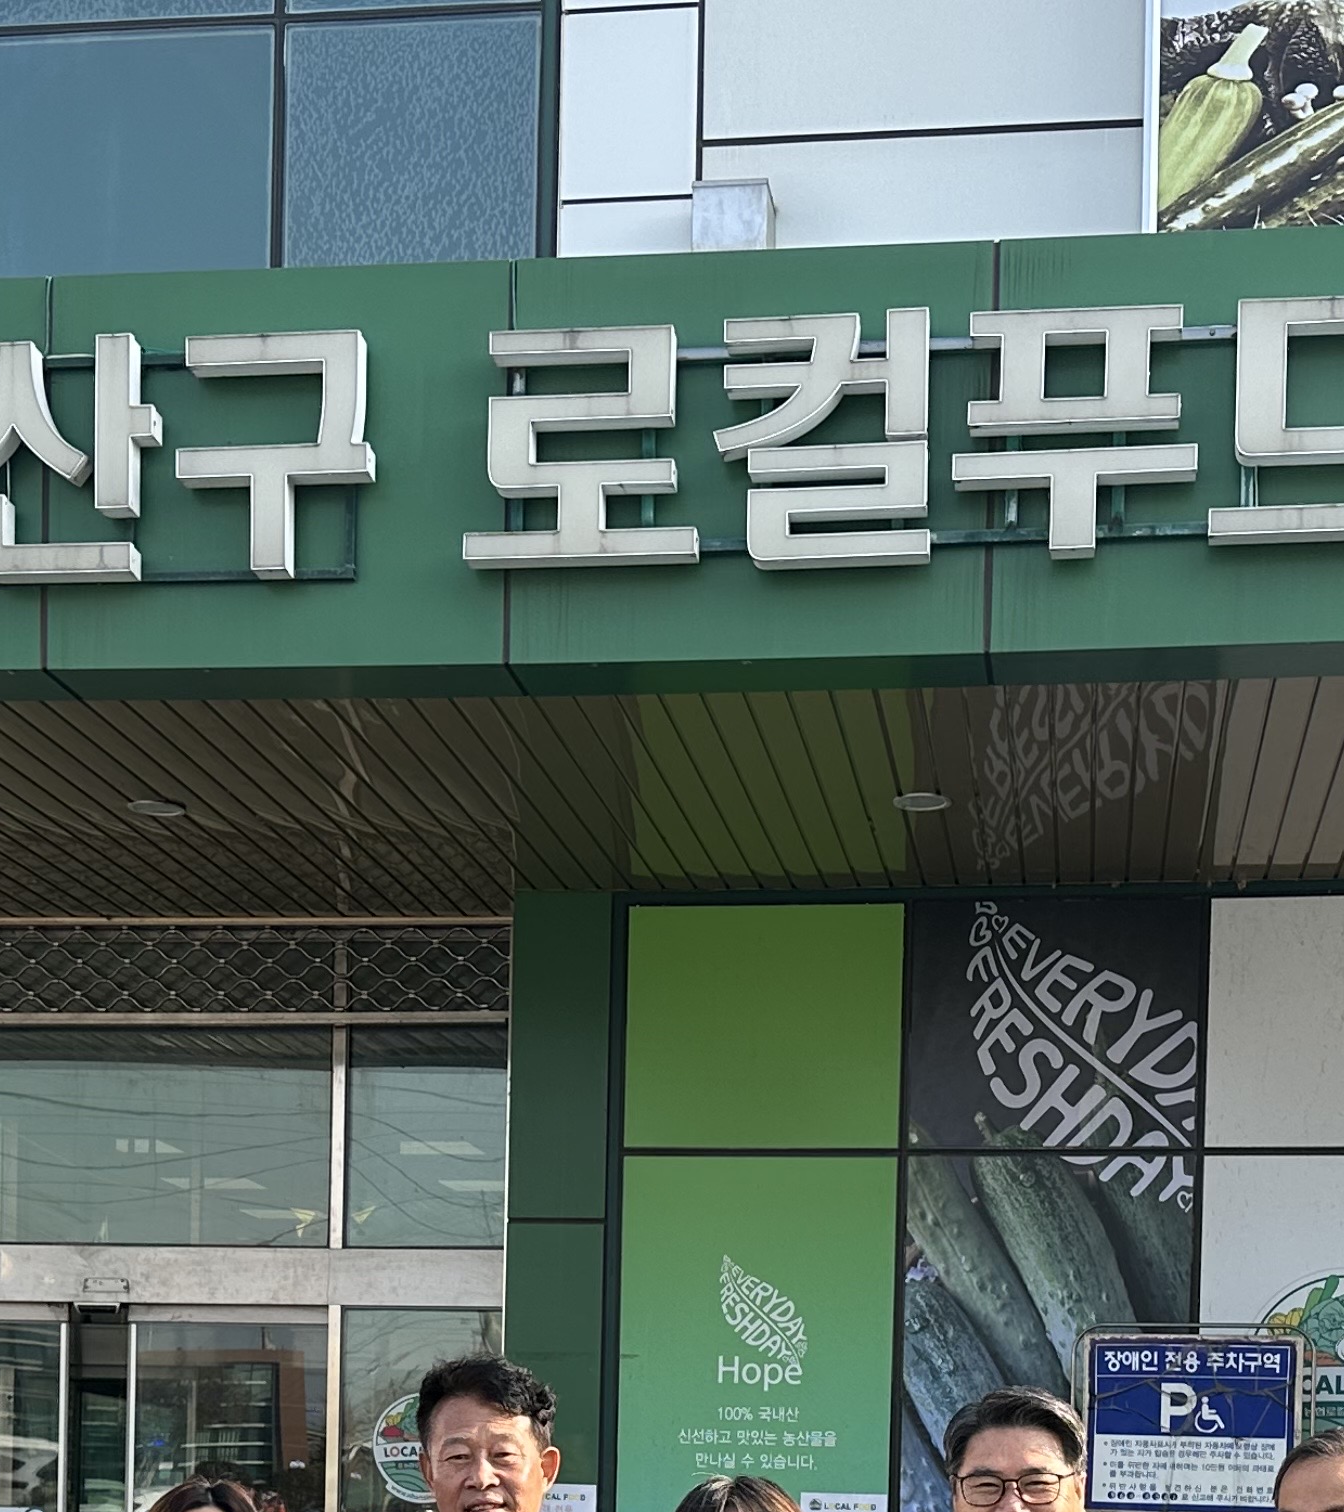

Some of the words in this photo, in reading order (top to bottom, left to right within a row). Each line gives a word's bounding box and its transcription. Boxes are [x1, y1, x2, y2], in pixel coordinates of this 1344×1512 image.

[1104, 1350, 1158, 1372] 장애인
[1164, 1351, 1201, 1373] 전용
[1207, 1352, 1281, 1374] 주차구역
[717, 1355, 803, 1392] Hope
[717, 1406, 754, 1421] 100%
[758, 1406, 800, 1423] 국내산
[1159, 1382, 1198, 1434] P
[677, 1428, 732, 1445] 신선하고
[737, 1429, 778, 1446] 맛있는
[782, 1430, 838, 1447] 농산물을
[694, 1452, 736, 1470] 만나실
[740, 1453, 755, 1470] 수
[759, 1453, 818, 1471] 있습니다.
